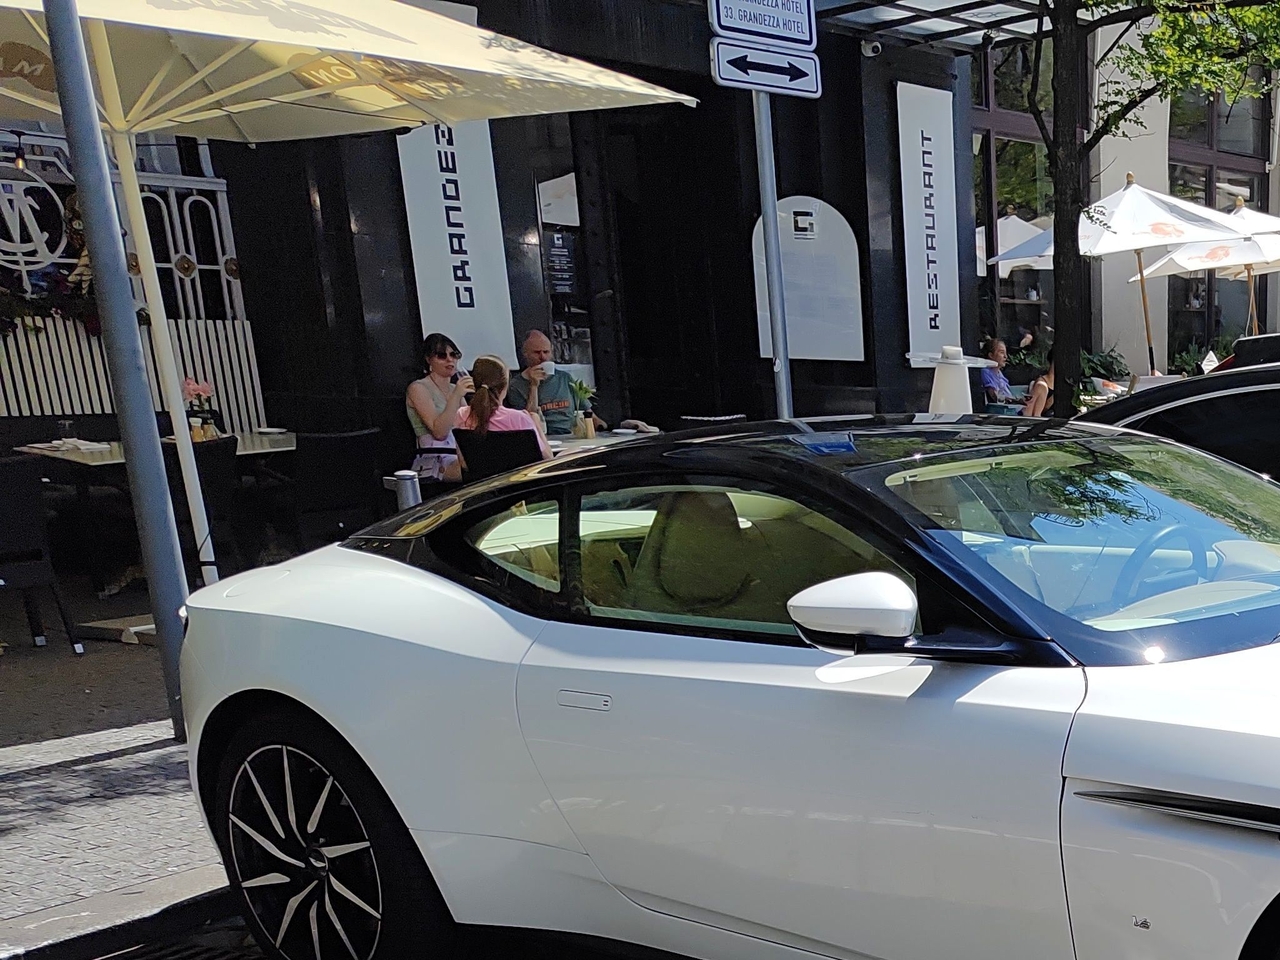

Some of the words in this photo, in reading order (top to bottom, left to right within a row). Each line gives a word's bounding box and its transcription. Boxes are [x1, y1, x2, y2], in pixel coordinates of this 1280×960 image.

[723, 6, 736, 20] 33.
[738, 9, 781, 29] GRANDEZZA
[782, 18, 805, 34] HOTEL
[781, 0, 804, 15] HOTEL
[920, 129, 940, 330] RESTAURANT
